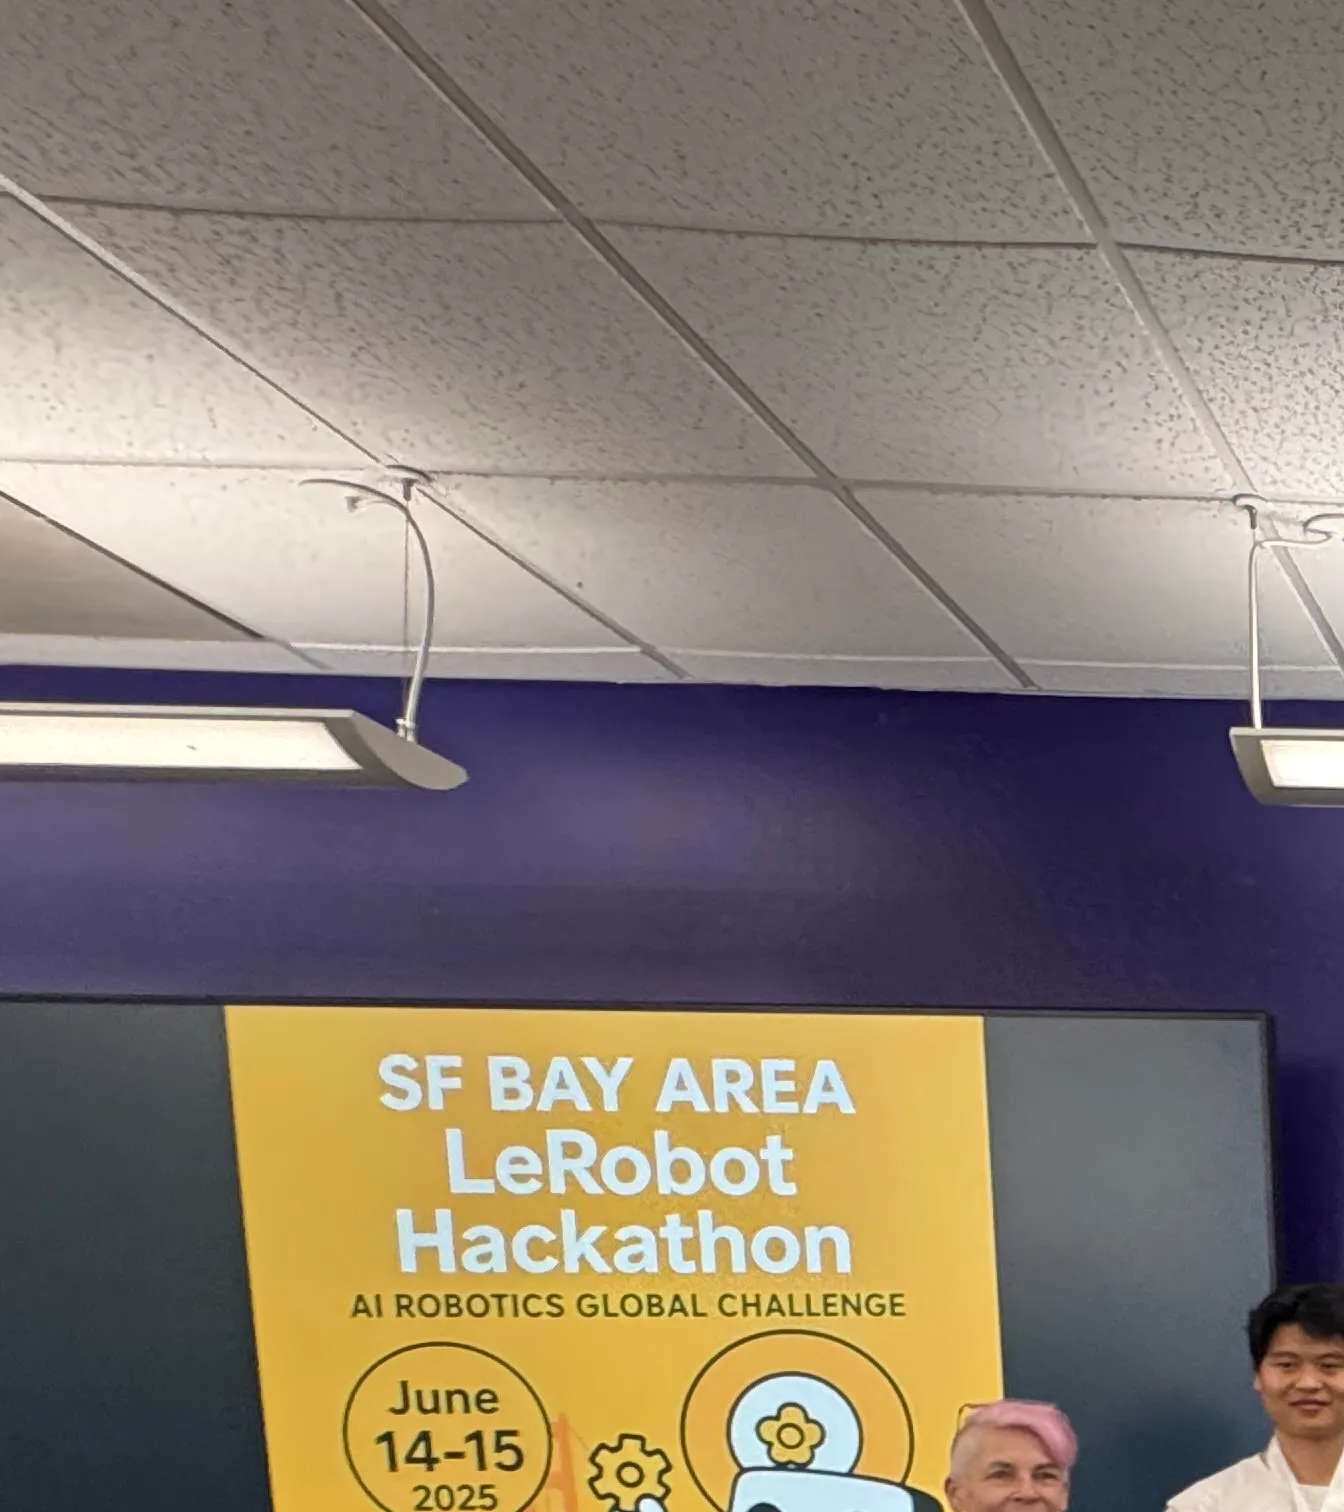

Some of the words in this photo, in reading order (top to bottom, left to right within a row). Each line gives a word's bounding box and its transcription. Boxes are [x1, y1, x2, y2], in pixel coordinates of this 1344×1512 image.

[378, 1052, 464, 1112] SF
[486, 1054, 635, 1113] BAY
[654, 1056, 857, 1115] AREA
[444, 1127, 799, 1197] LeRobot
[395, 1207, 853, 1275] Hackathon
[351, 1293, 384, 1319] AI
[394, 1292, 566, 1319] ROBOTICS
[575, 1292, 708, 1319] GLOBAL
[717, 1292, 906, 1318] CHALLENGE
[389, 1380, 500, 1416] June
[375, 1429, 525, 1474] 14-15
[413, 1484, 498, 1512] 2025
